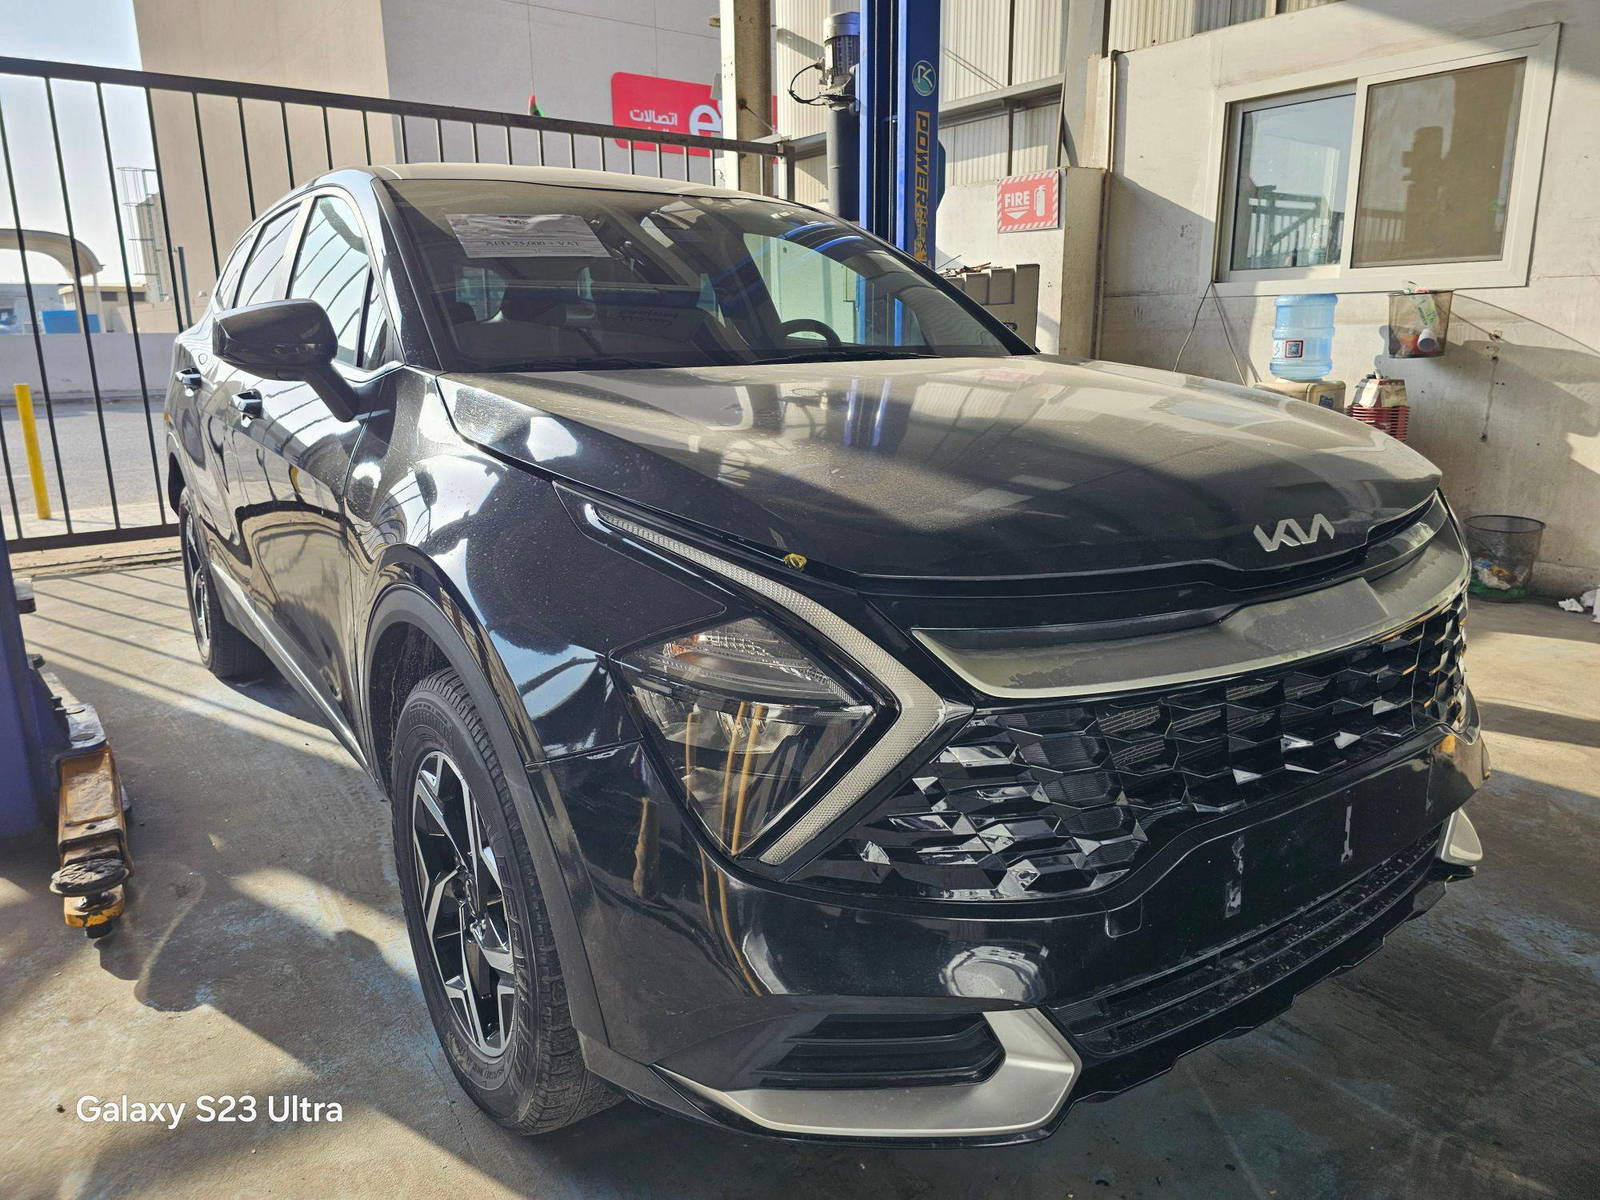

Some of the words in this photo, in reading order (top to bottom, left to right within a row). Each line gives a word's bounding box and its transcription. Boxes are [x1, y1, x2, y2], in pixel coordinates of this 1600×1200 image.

[629, 109, 678, 126] اتصالات
[1004, 190, 1030, 208] FIRE
[1253, 513, 1335, 552] KIA
